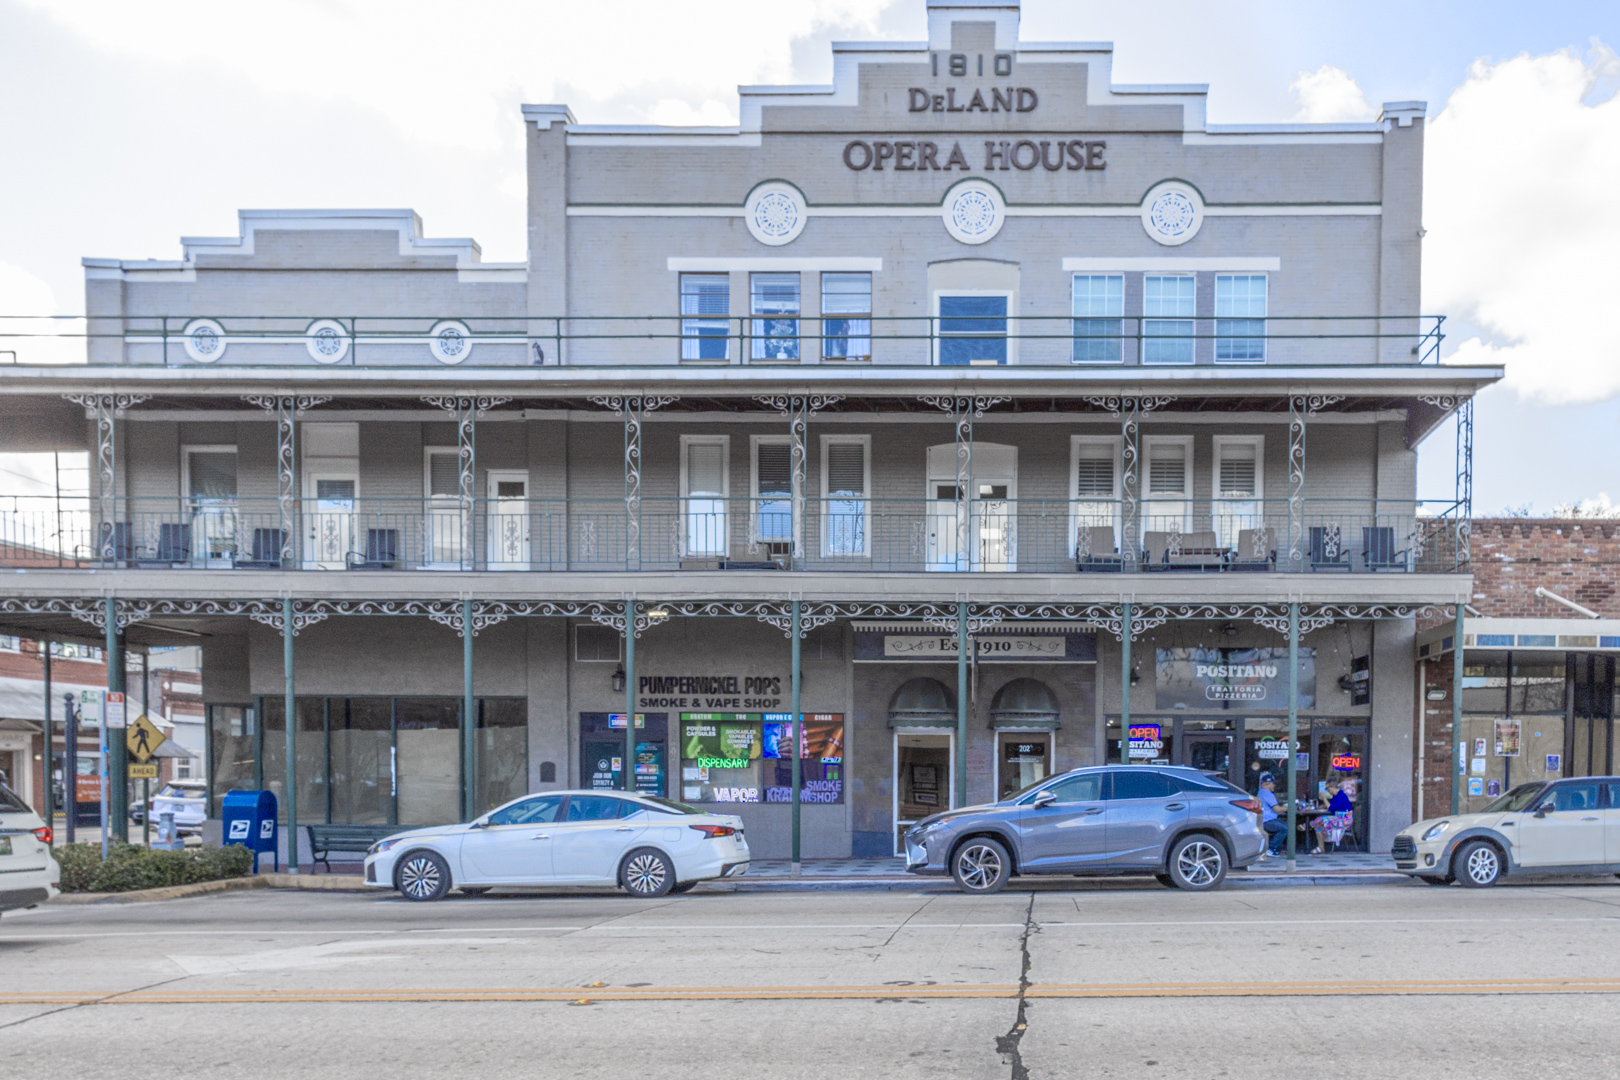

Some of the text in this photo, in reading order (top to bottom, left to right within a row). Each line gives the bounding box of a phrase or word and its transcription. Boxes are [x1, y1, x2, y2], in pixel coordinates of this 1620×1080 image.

[931, 53, 1012, 76] 1910
[843, 140, 1107, 171] OPERA HOUSE
[939, 639, 1011, 654] Es. 1910
[1196, 665, 1278, 678] POSITANO
[639, 676, 781, 695] PUMPERNICKEL POPS
[640, 698, 780, 708] SMOKE & VAPE SHOP
[1129, 727, 1159, 739] OPEN
[1118, 741, 1164, 749] PSITANO
[1254, 741, 1301, 750] POSITAO
[697, 757, 749, 768] DISPENSARY
[1332, 757, 1360, 768] OPEN
[806, 780, 842, 791] SMOKE
[713, 787, 758, 803] VAPOR
[811, 792, 838, 802] SHOP
